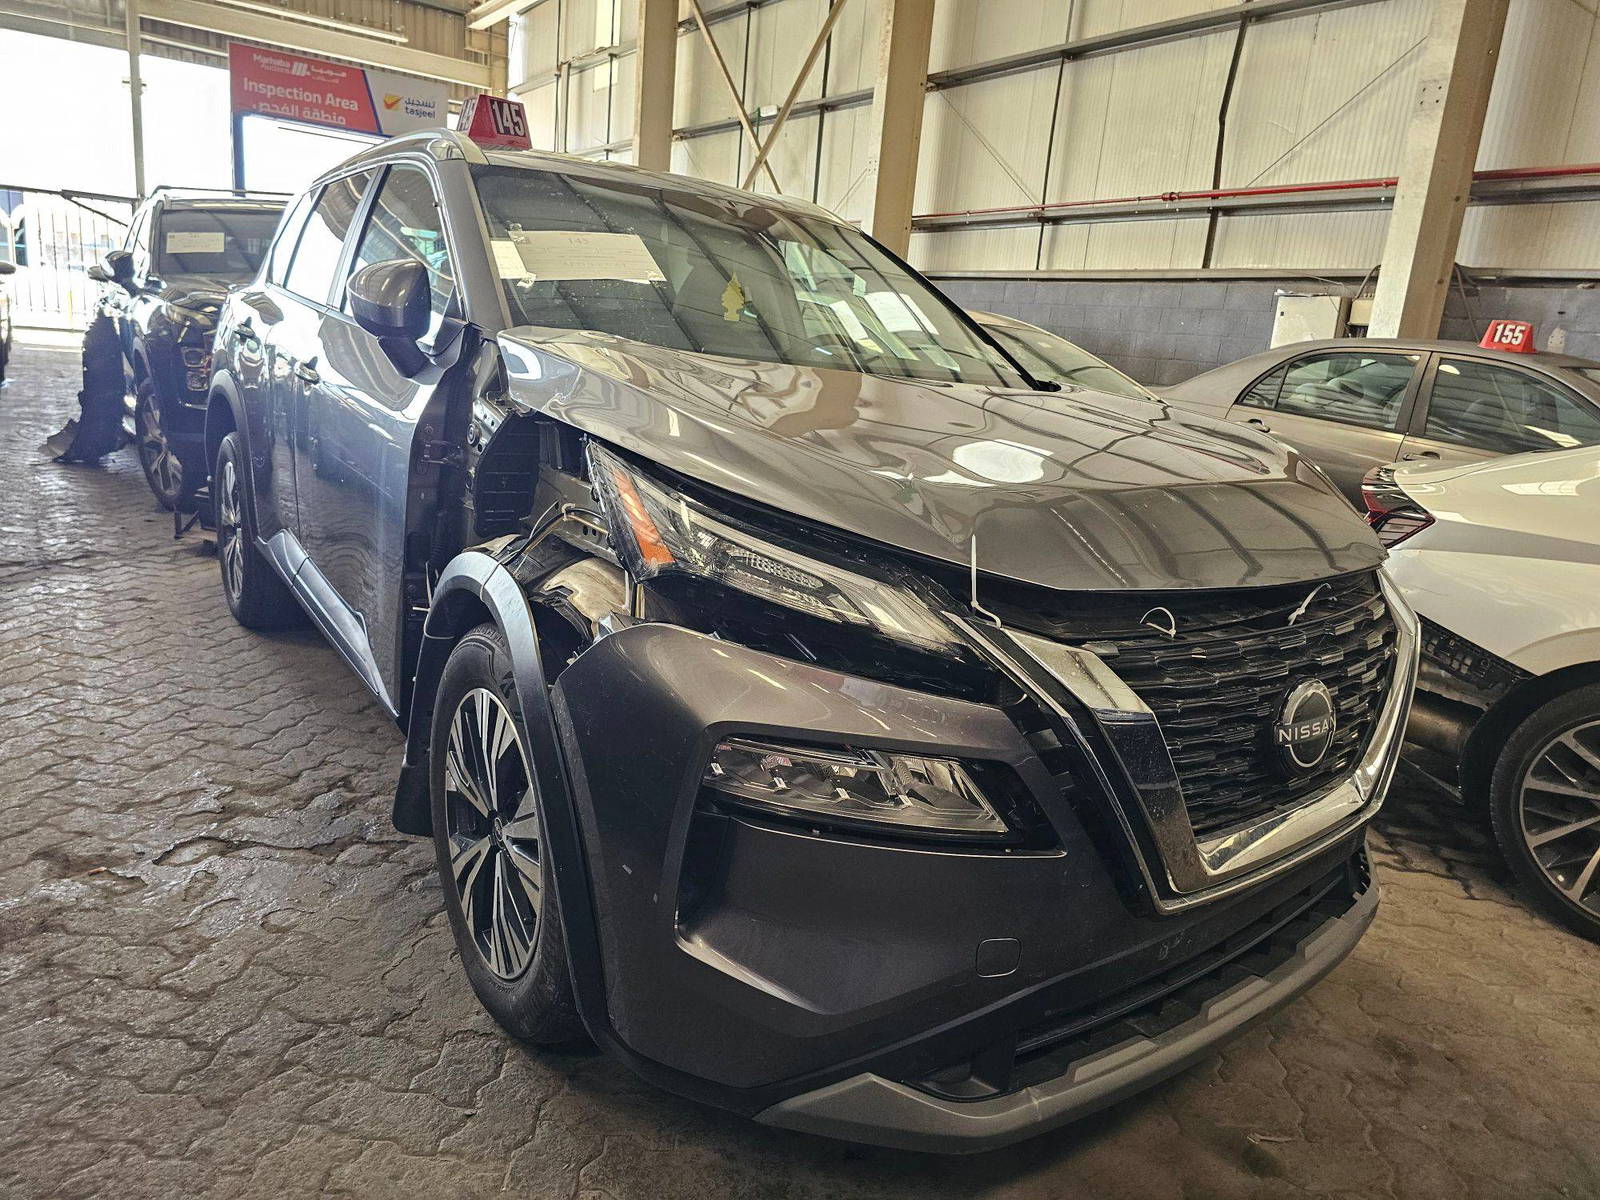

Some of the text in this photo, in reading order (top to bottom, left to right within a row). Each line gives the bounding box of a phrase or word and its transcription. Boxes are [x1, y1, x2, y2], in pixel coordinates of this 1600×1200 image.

[243, 78, 359, 112] Inspection Area
[303, 106, 346, 125] منطقة
[405, 106, 436, 119] tasjeel
[492, 100, 525, 137] 145
[1493, 323, 1526, 345] 155
[1279, 715, 1337, 743] NISSAN
